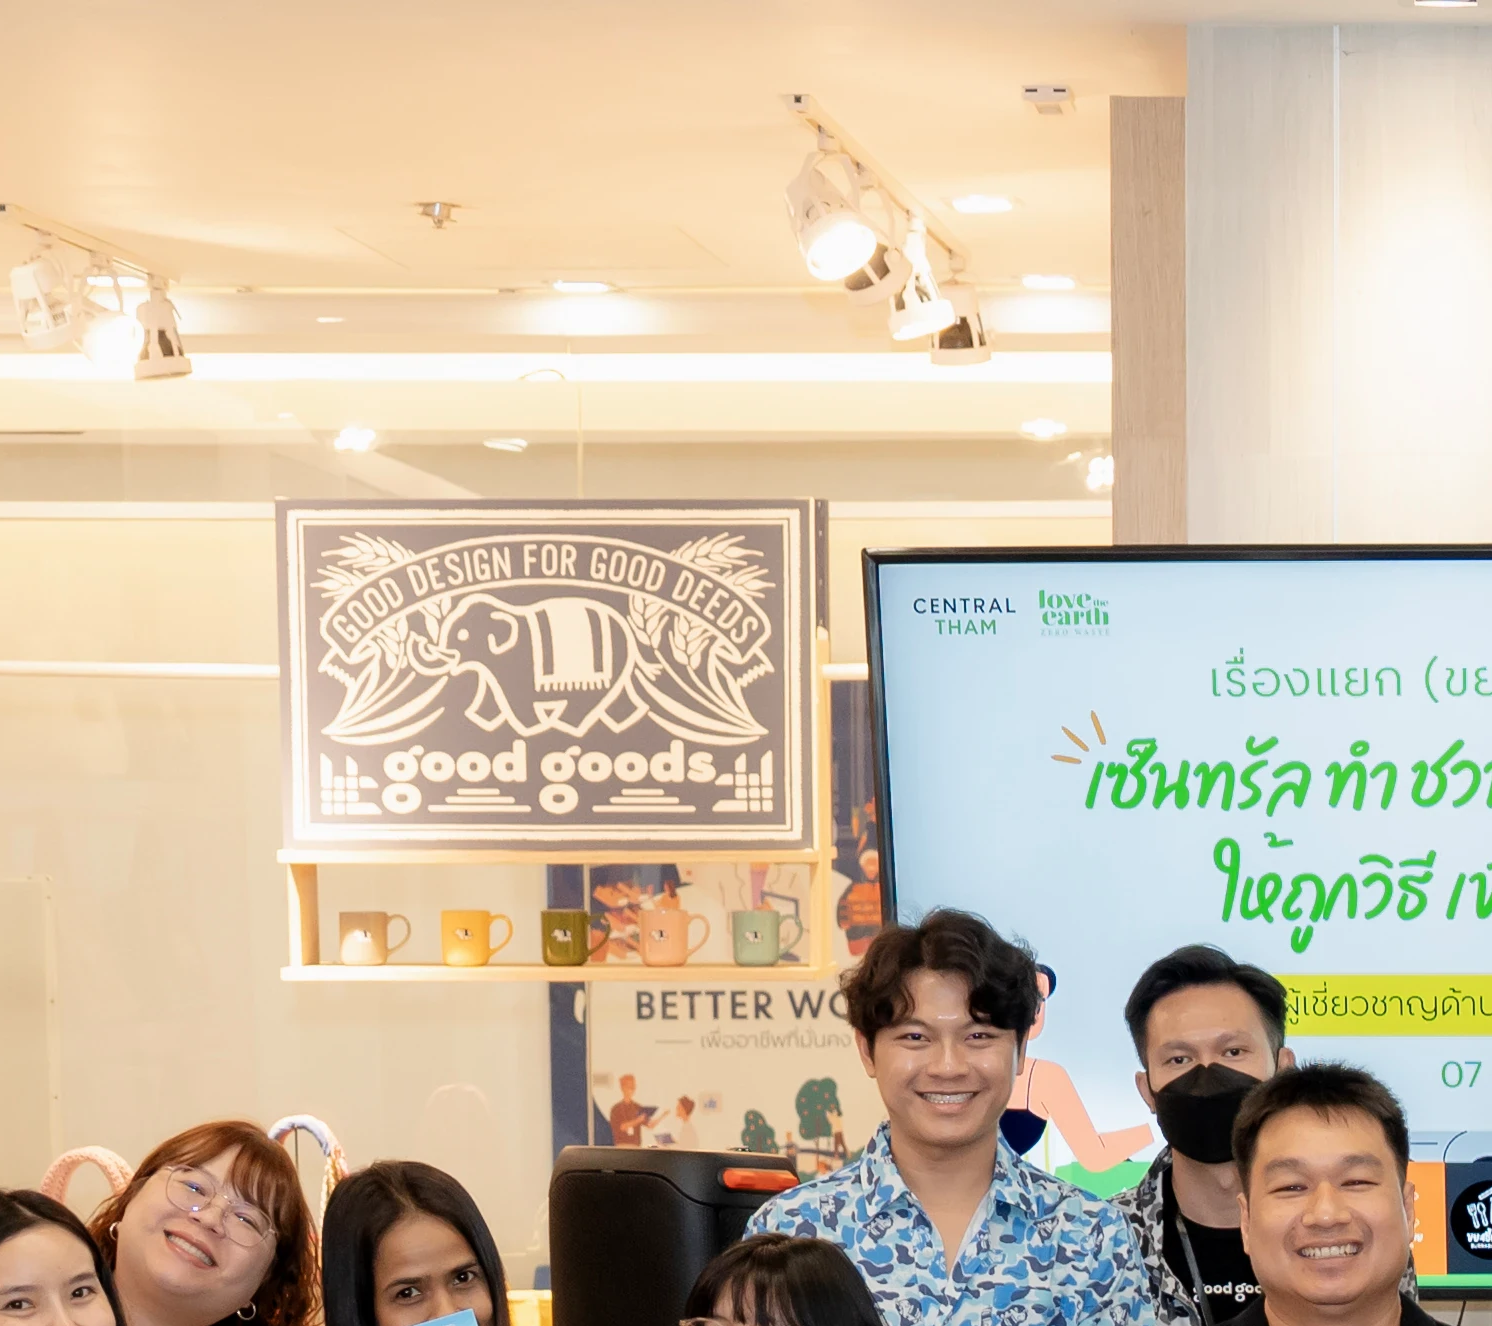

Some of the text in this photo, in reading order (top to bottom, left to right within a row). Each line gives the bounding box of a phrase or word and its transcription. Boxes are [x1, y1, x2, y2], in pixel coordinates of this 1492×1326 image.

[332, 542, 760, 645] GOOD DESIGN FOR GOOD DEEDS
[912, 597, 1017, 615] CENTRAL
[1038, 589, 1092, 609] love
[934, 619, 998, 636] THAM
[1041, 608, 1110, 627] earth
[1211, 648, 1403, 698] เรื่องแยก
[381, 739, 717, 814] good goods
[1085, 736, 1312, 817] เซ็นทรัล
[1325, 740, 1398, 811] ทำ
[1213, 832, 1437, 953] ให้ถูกวิธี
[635, 990, 775, 1020] BETTER
[1441, 1061, 1482, 1089] 07
